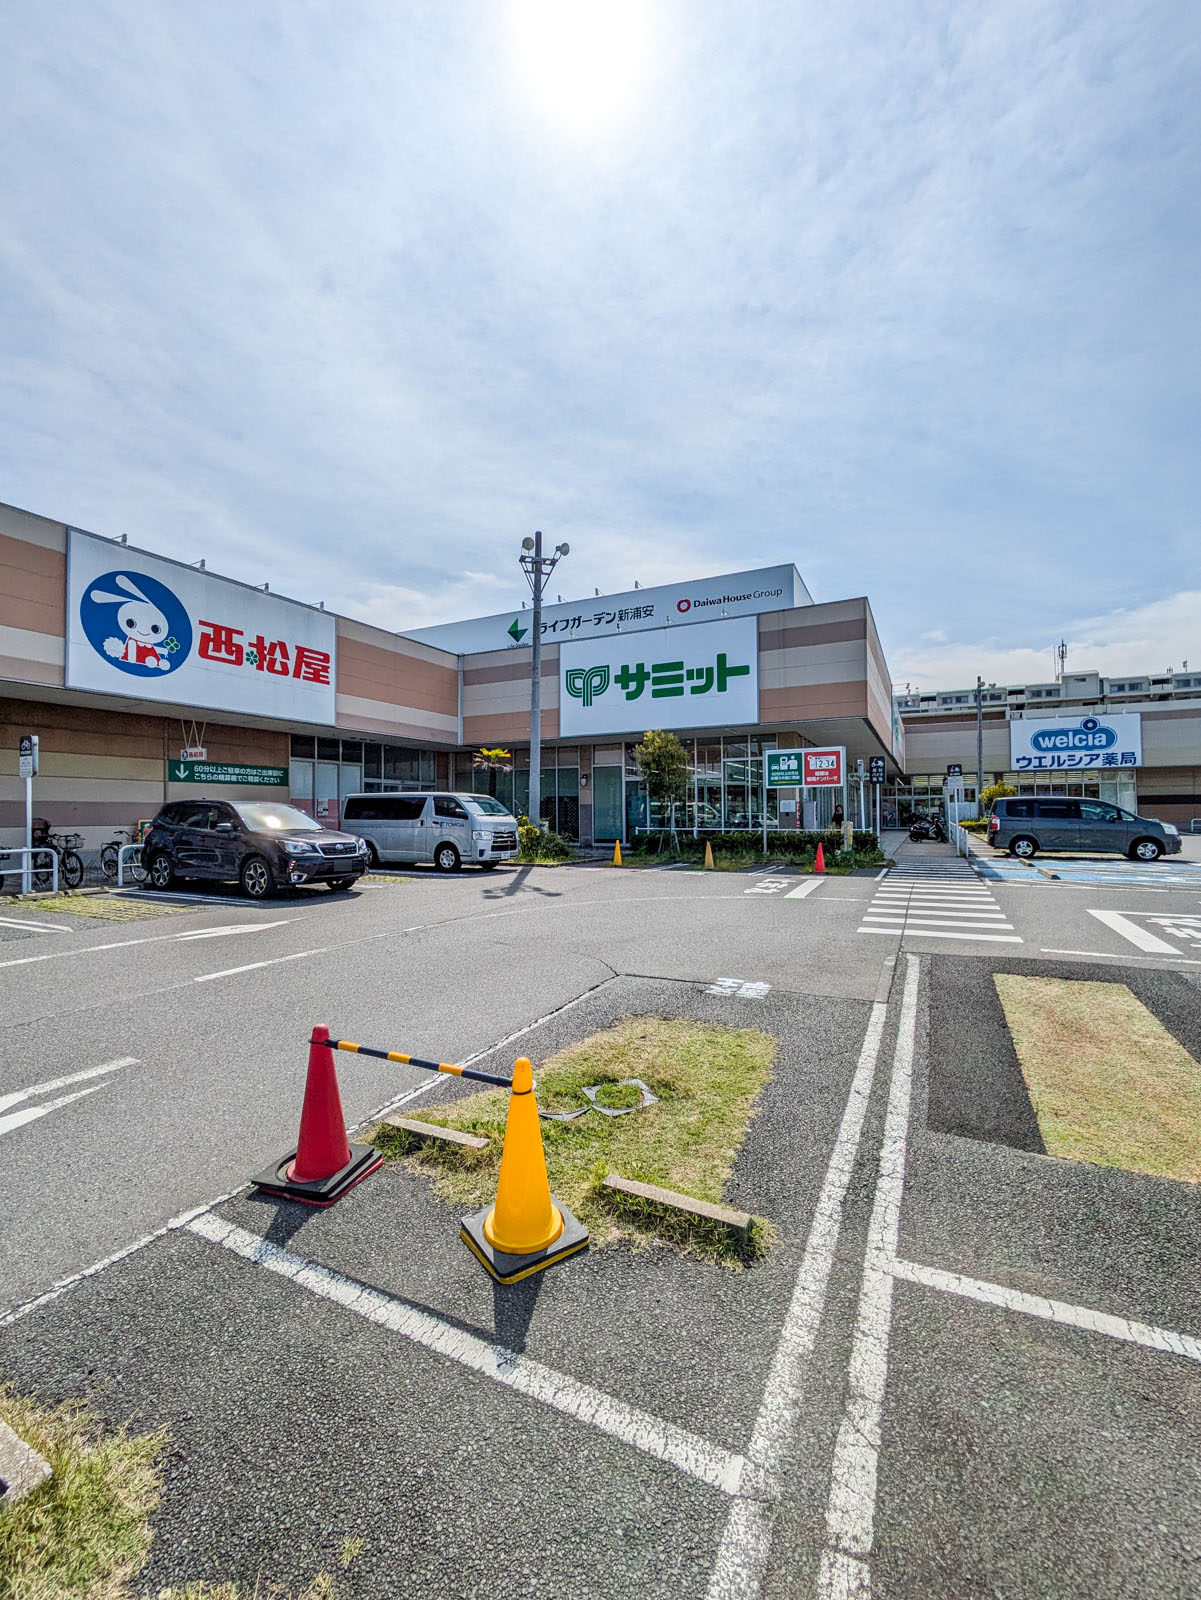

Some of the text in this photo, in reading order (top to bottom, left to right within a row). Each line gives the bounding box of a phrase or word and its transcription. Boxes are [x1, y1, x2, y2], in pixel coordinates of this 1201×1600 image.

[693, 588, 783, 608] Daiwa House Group
[540, 604, 655, 635] ライフガーデン新浦安
[198, 619, 331, 686] 西松屋
[614, 653, 750, 701] サミット
[1038, 731, 1107, 748] welcia
[1016, 752, 1137, 769] ウエルシア薬局
